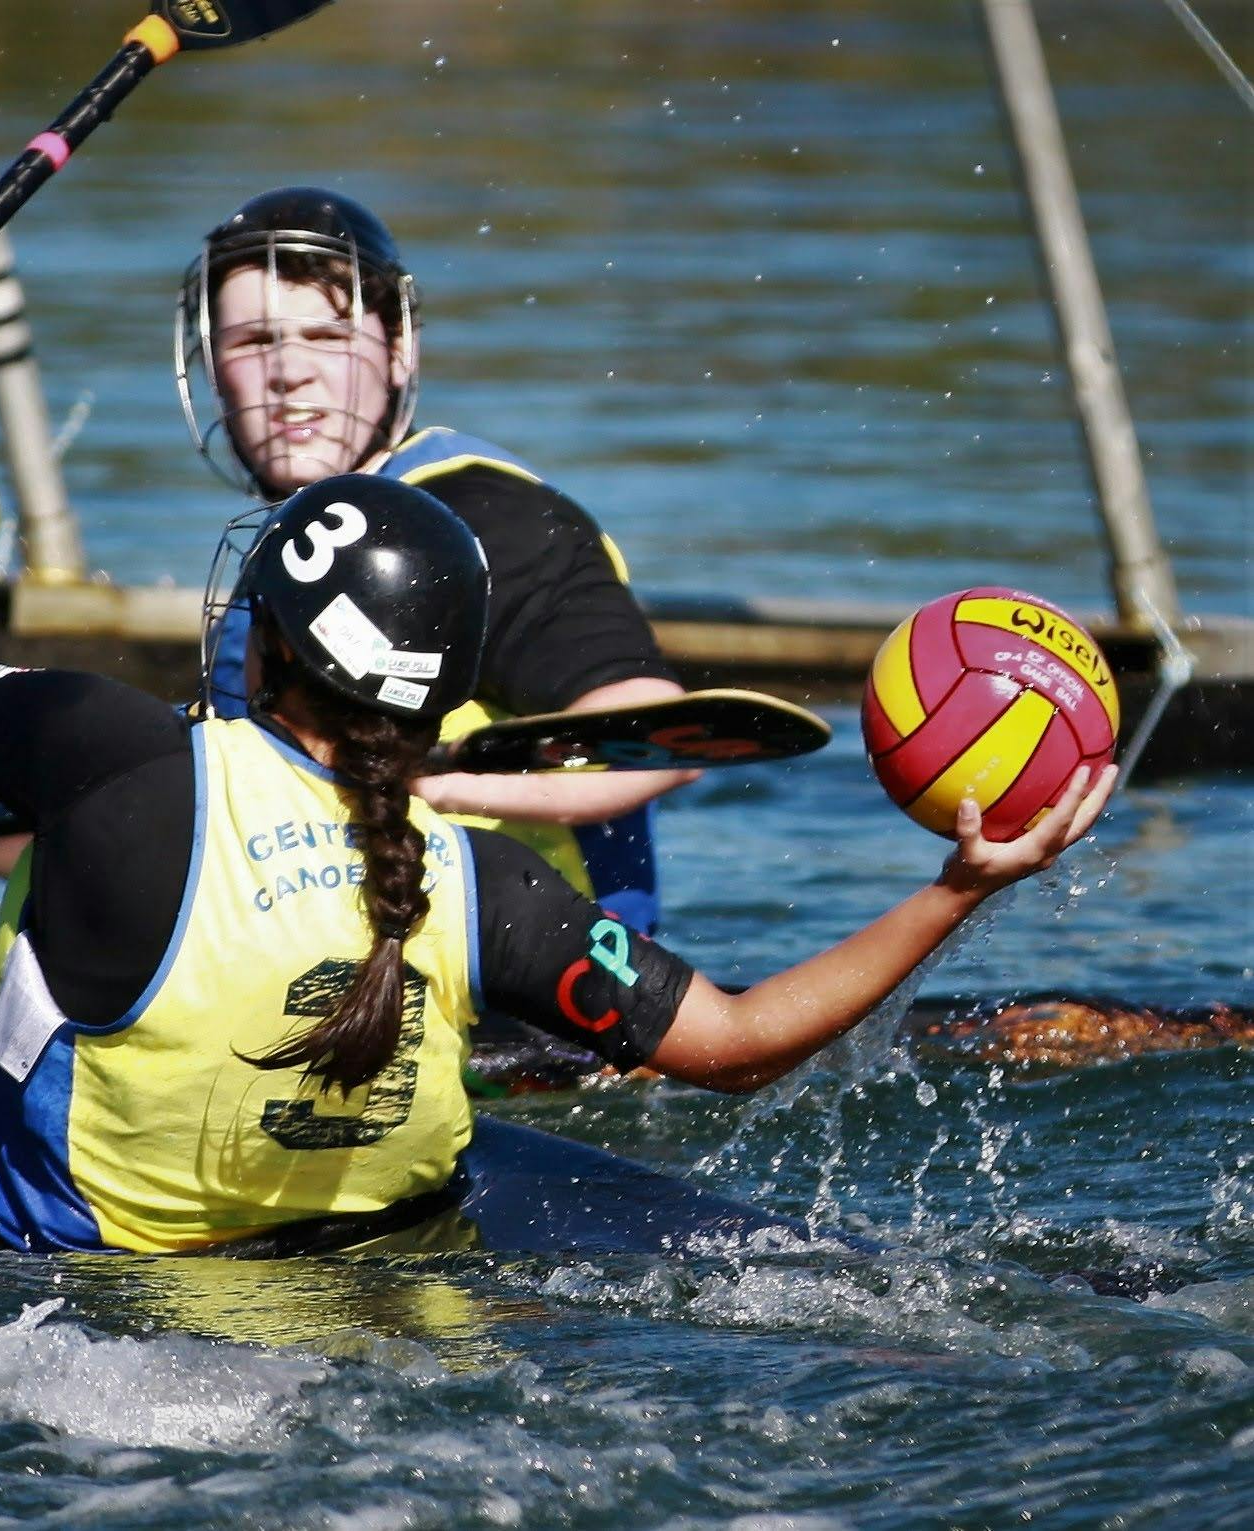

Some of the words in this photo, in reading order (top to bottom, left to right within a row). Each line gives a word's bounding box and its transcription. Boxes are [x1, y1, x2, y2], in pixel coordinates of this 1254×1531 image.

[281, 502, 368, 583] 3
[1011, 607, 1111, 687] Wisely
[1054, 685, 1079, 713] BALL
[253, 863, 367, 912] CANOE
[259, 957, 429, 1150] 3
